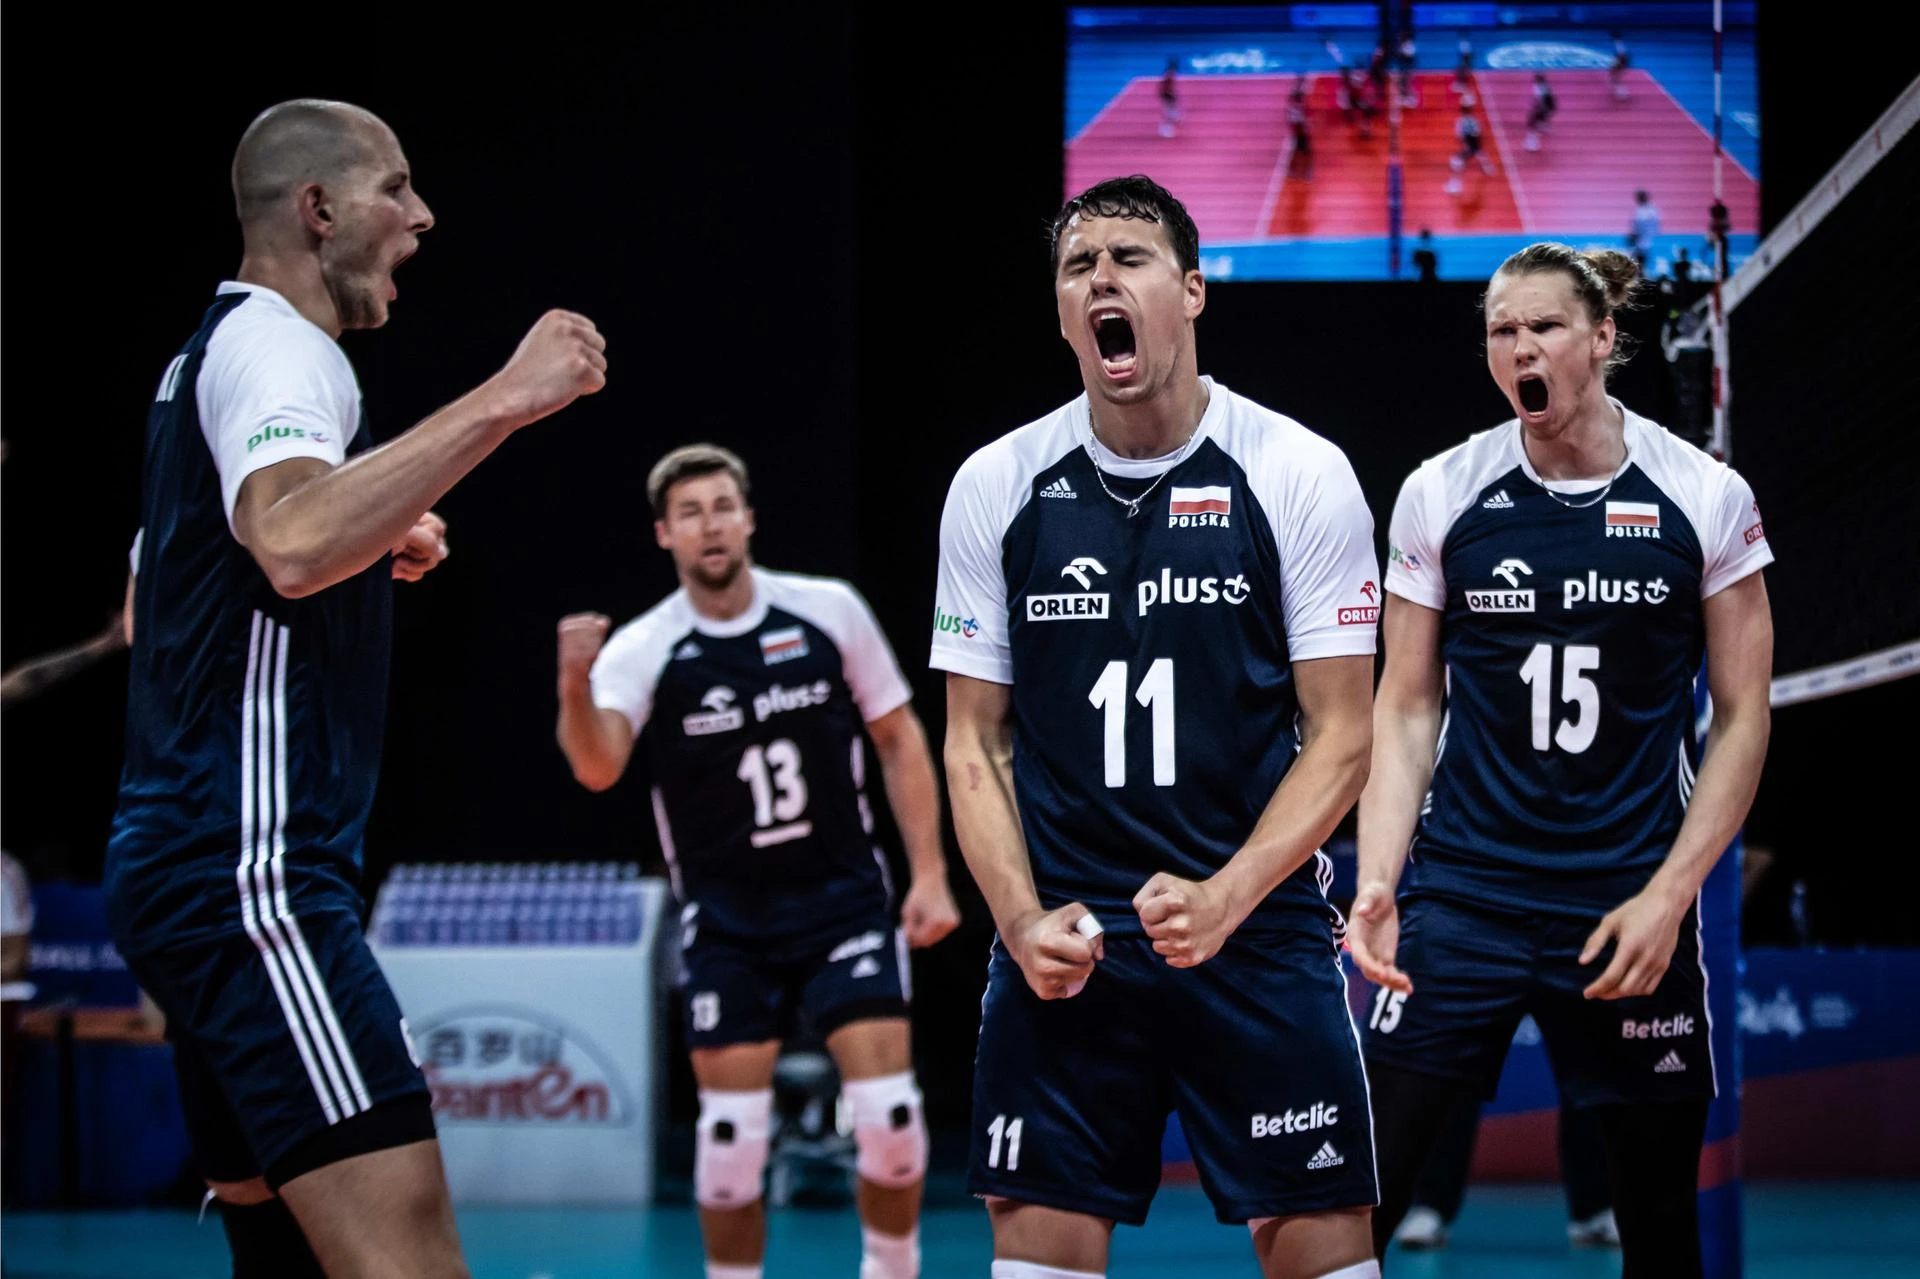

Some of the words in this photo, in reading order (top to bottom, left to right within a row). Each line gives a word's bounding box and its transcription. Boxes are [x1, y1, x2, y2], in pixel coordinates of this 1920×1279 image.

[246, 425, 305, 453] plus
[1039, 489, 1078, 499] adidas
[1482, 501, 1515, 509] adidas
[1168, 514, 1230, 529] POLSKA
[1605, 526, 1661, 539] POLSKA
[1138, 567, 1220, 617] plus
[1469, 593, 1530, 610] ORLEN
[1562, 570, 1641, 610] plus
[934, 606, 962, 635] lus
[1030, 597, 1103, 617] ORLEN
[1519, 643, 1600, 754] 15
[1088, 658, 1176, 788] 11
[736, 738, 808, 827] 13
[1369, 986, 1408, 1034] 15
[1622, 1013, 1695, 1039] Betclic
[1251, 1101, 1339, 1139] Betclic
[986, 1112, 1025, 1172] 11
[1306, 1155, 1345, 1170] adidas
